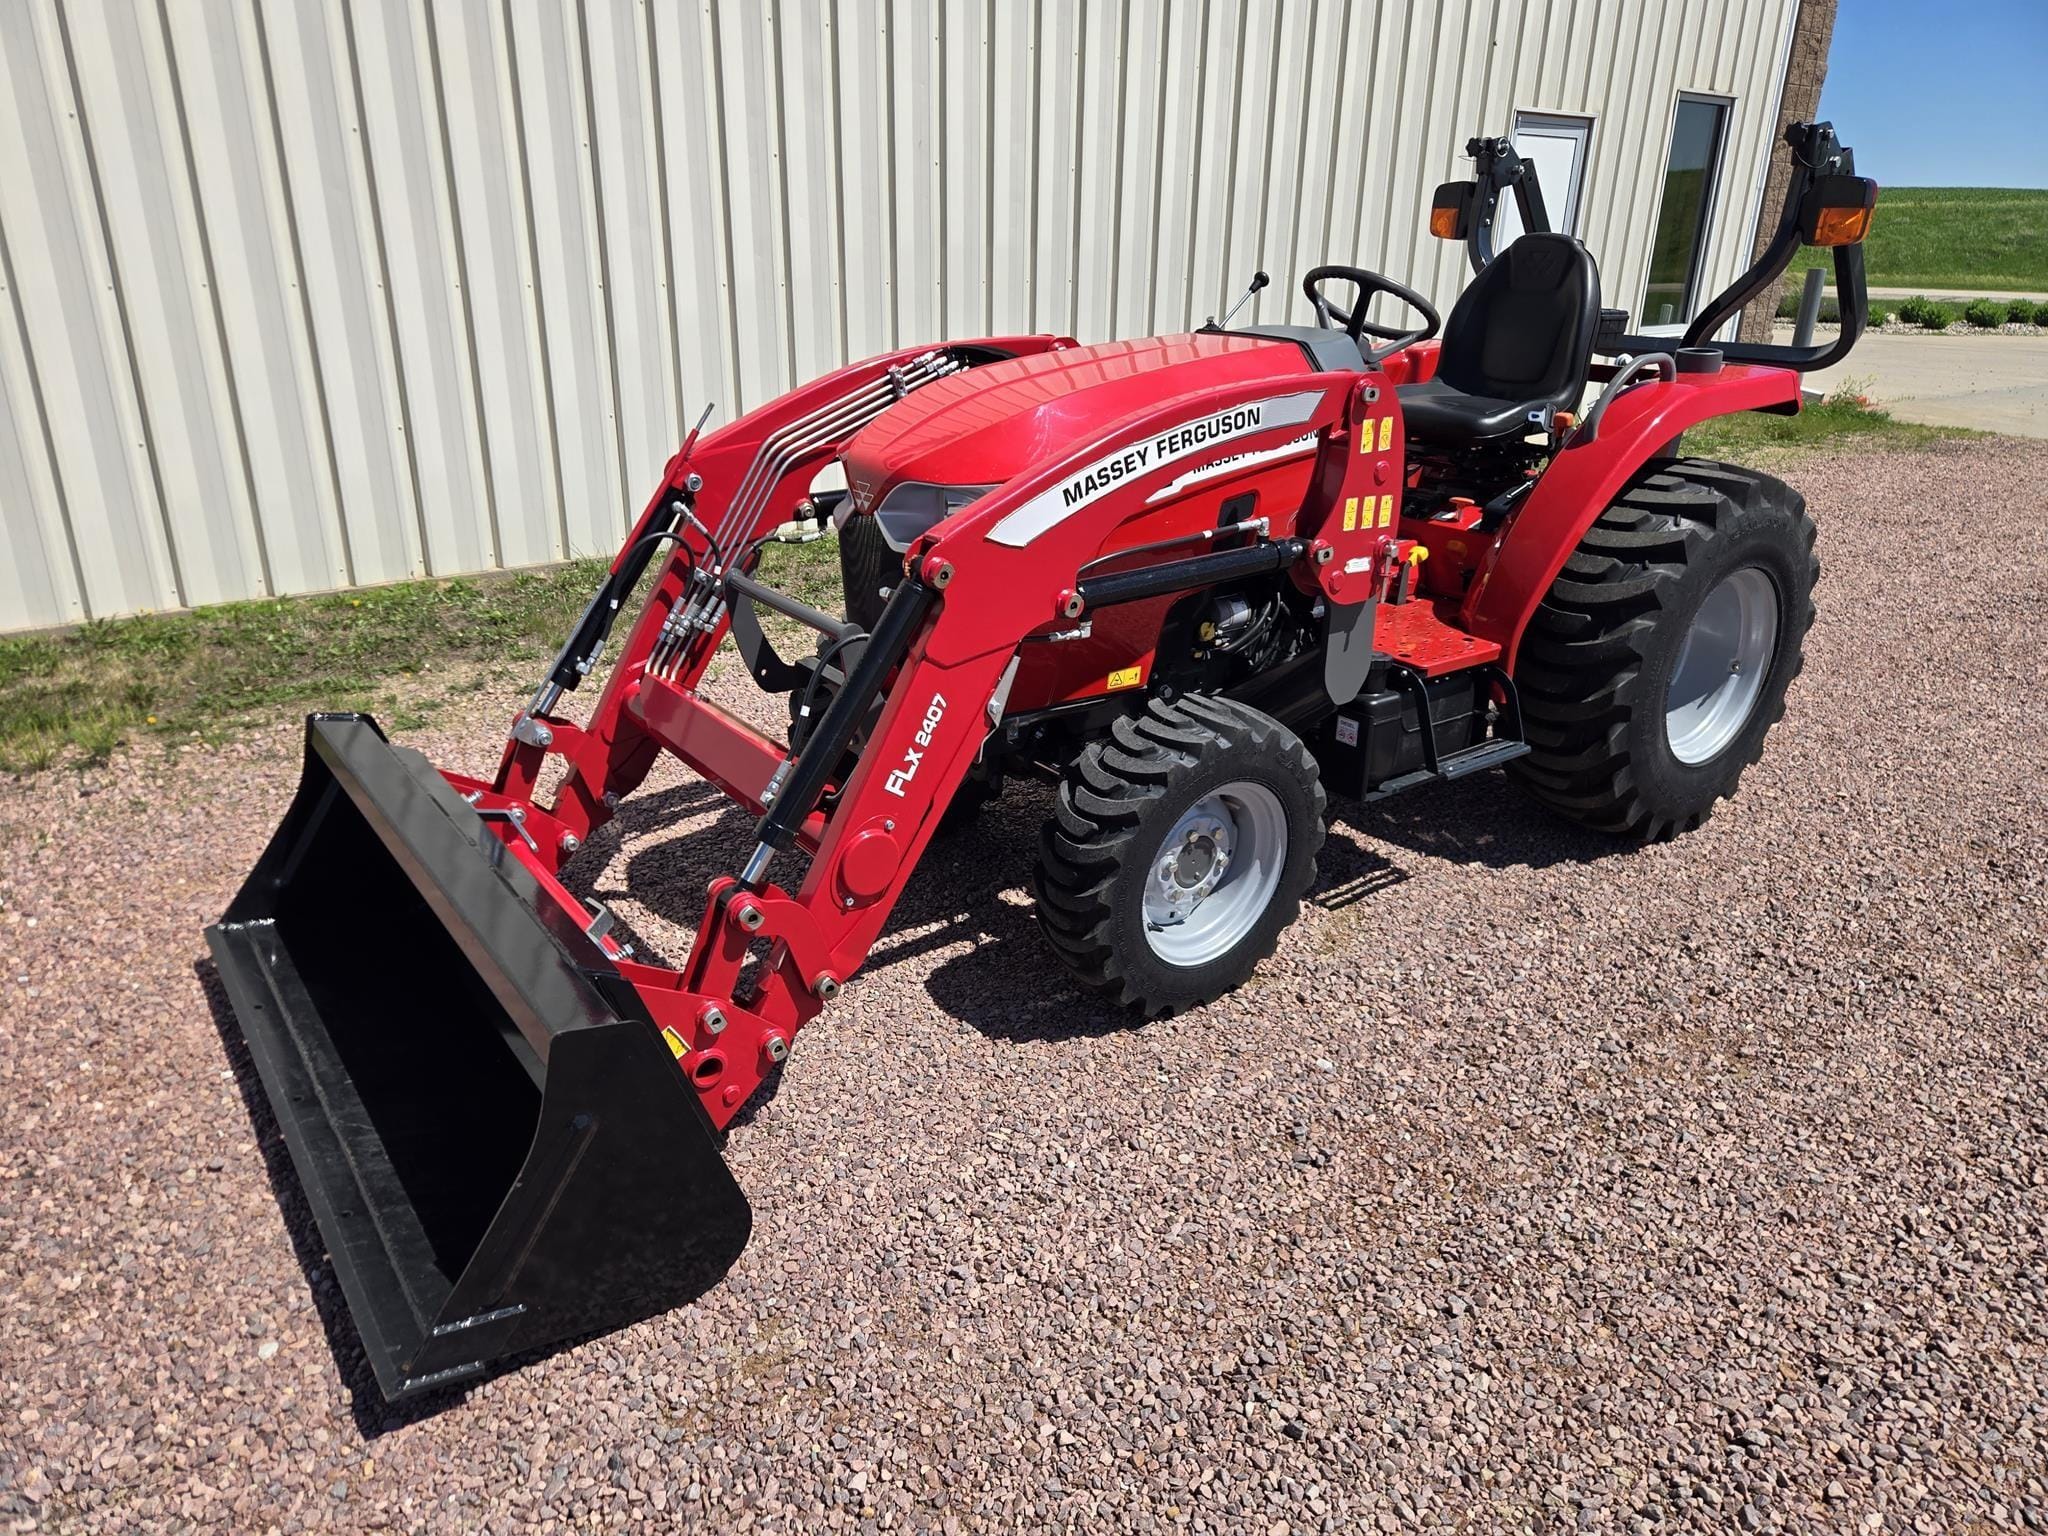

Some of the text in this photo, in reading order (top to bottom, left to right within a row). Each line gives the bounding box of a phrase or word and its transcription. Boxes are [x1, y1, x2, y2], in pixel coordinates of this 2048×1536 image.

[1062, 446, 1149, 507] MASSEY
[1156, 406, 1261, 459] FERGUSON
[884, 692, 947, 797] FLX 2407
